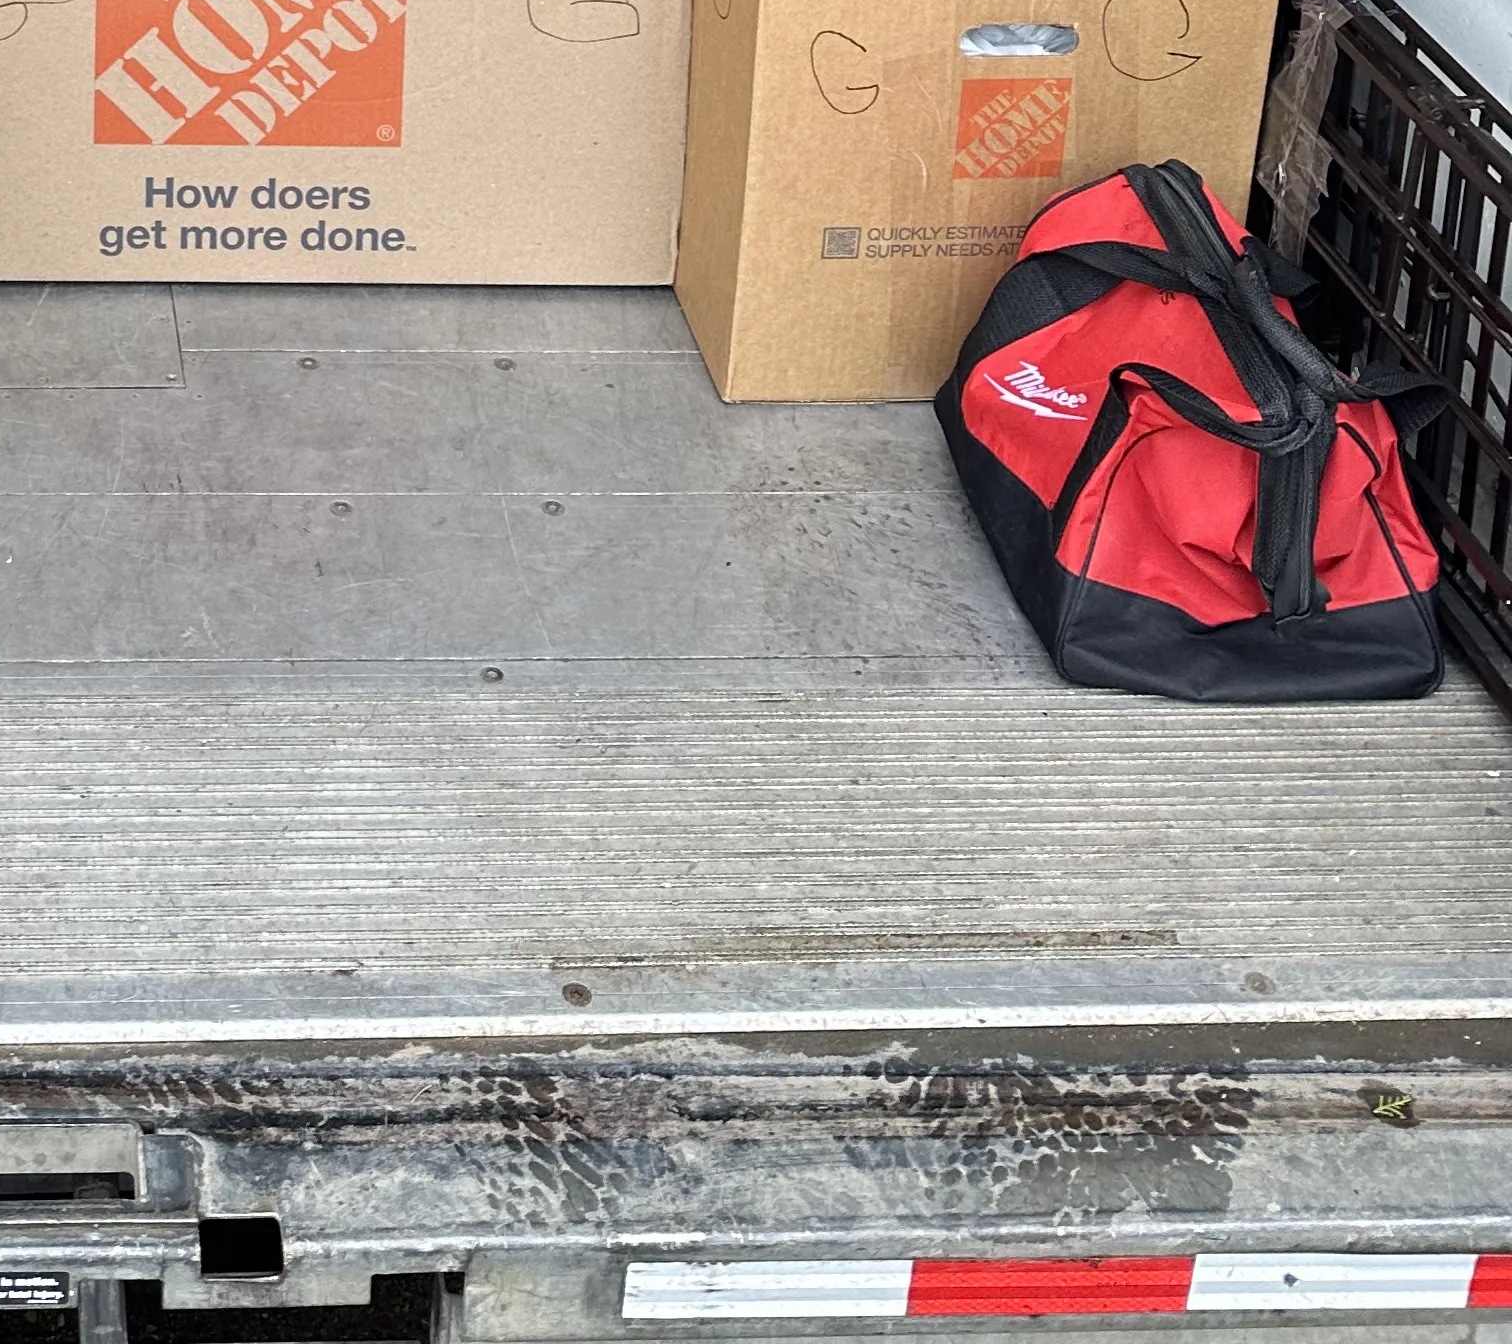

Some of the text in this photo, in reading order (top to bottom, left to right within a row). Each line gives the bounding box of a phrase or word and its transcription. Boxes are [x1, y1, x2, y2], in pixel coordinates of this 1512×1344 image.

[810, 30, 880, 115] G
[968, 89, 1017, 129] THE
[955, 79, 1076, 178] HOME
[995, 114, 1068, 178] DEPOT
[145, 177, 372, 211] How doers
[99, 220, 167, 257] get
[179, 225, 288, 251] more
[865, 242, 1021, 258] SUPPLY NEEDS AT
[867, 226, 942, 242] QUICKLY
